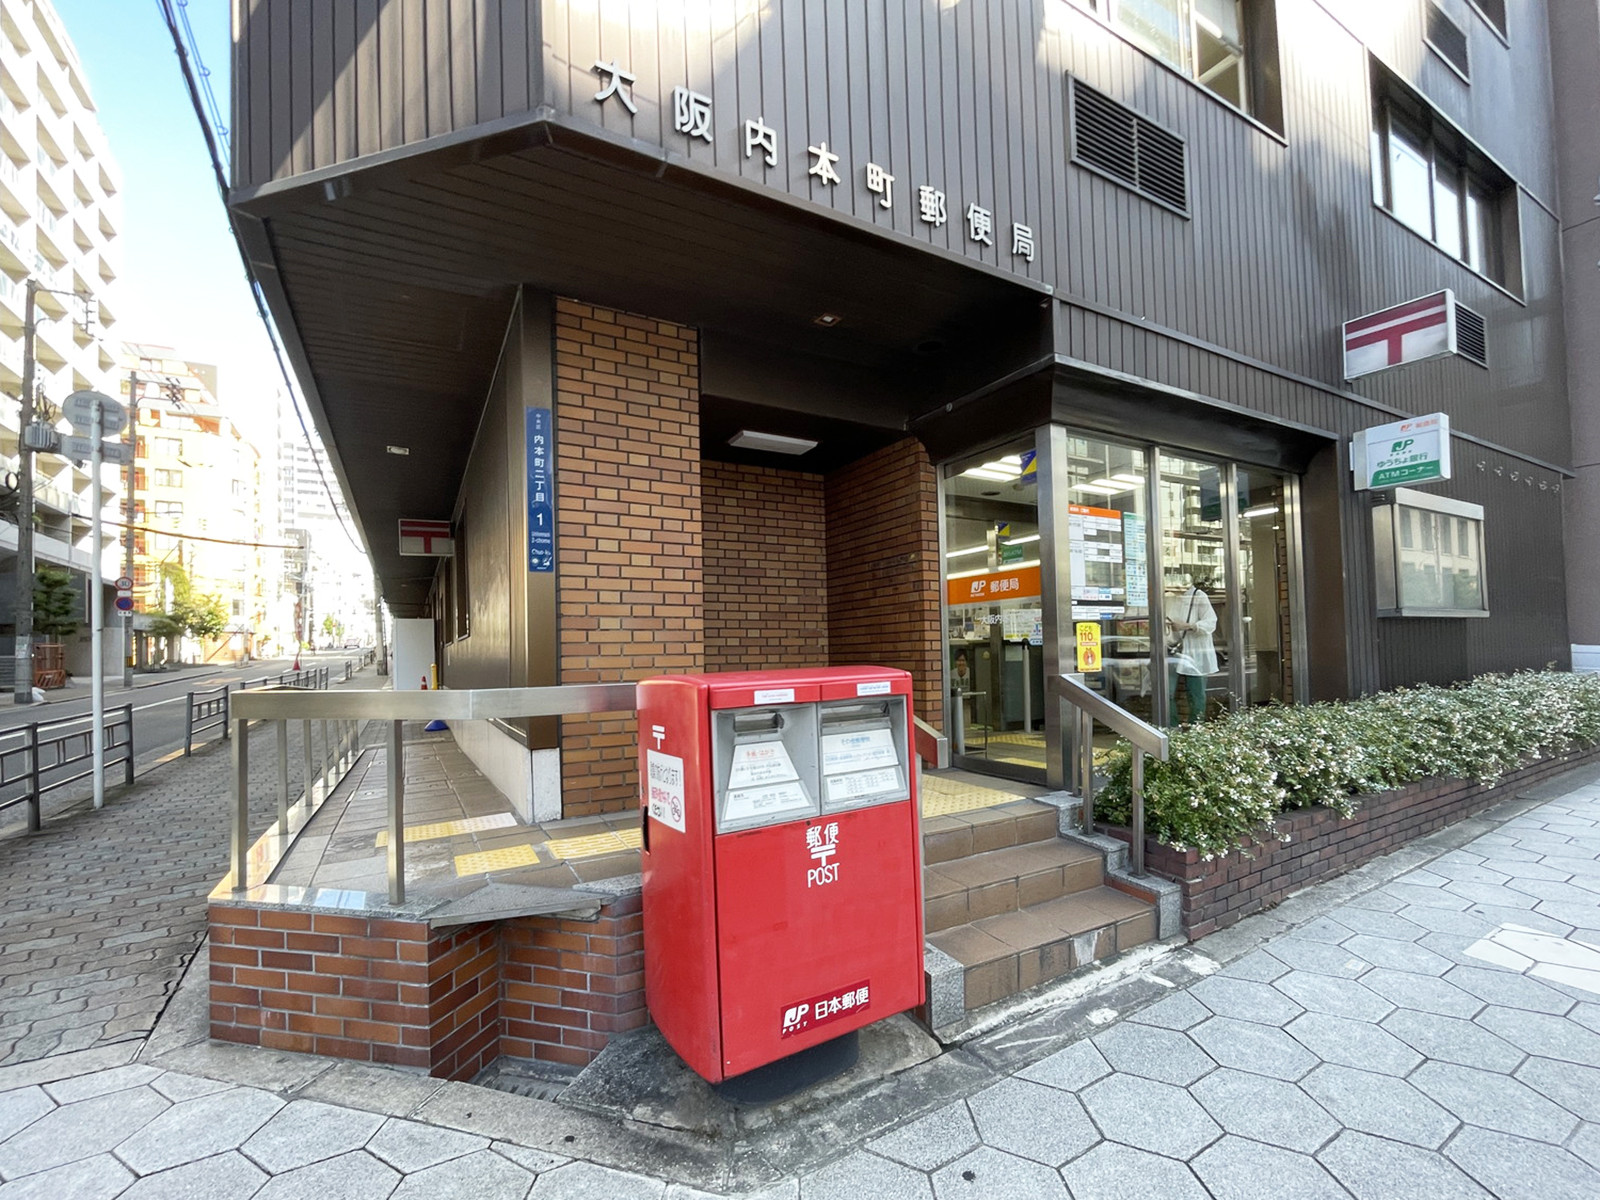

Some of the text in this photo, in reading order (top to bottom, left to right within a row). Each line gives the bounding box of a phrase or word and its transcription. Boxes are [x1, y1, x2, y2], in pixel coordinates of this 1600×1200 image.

[592, 58, 1035, 263] 大阪内本町郵便局
[1377, 452, 1428, 468] ゆうちょ銀行
[534, 435, 545, 502] 内本町二丁目
[1378, 466, 1434, 480] ATMコーナー
[536, 513, 543, 526] 1
[971, 578, 1019, 593] JP 郵便局
[1080, 632, 1093, 641] 110
[806, 822, 839, 849] 郵便
[807, 863, 840, 888] POST
[783, 986, 869, 1027] JP 日本郵便
[782, 1021, 808, 1034] POST
